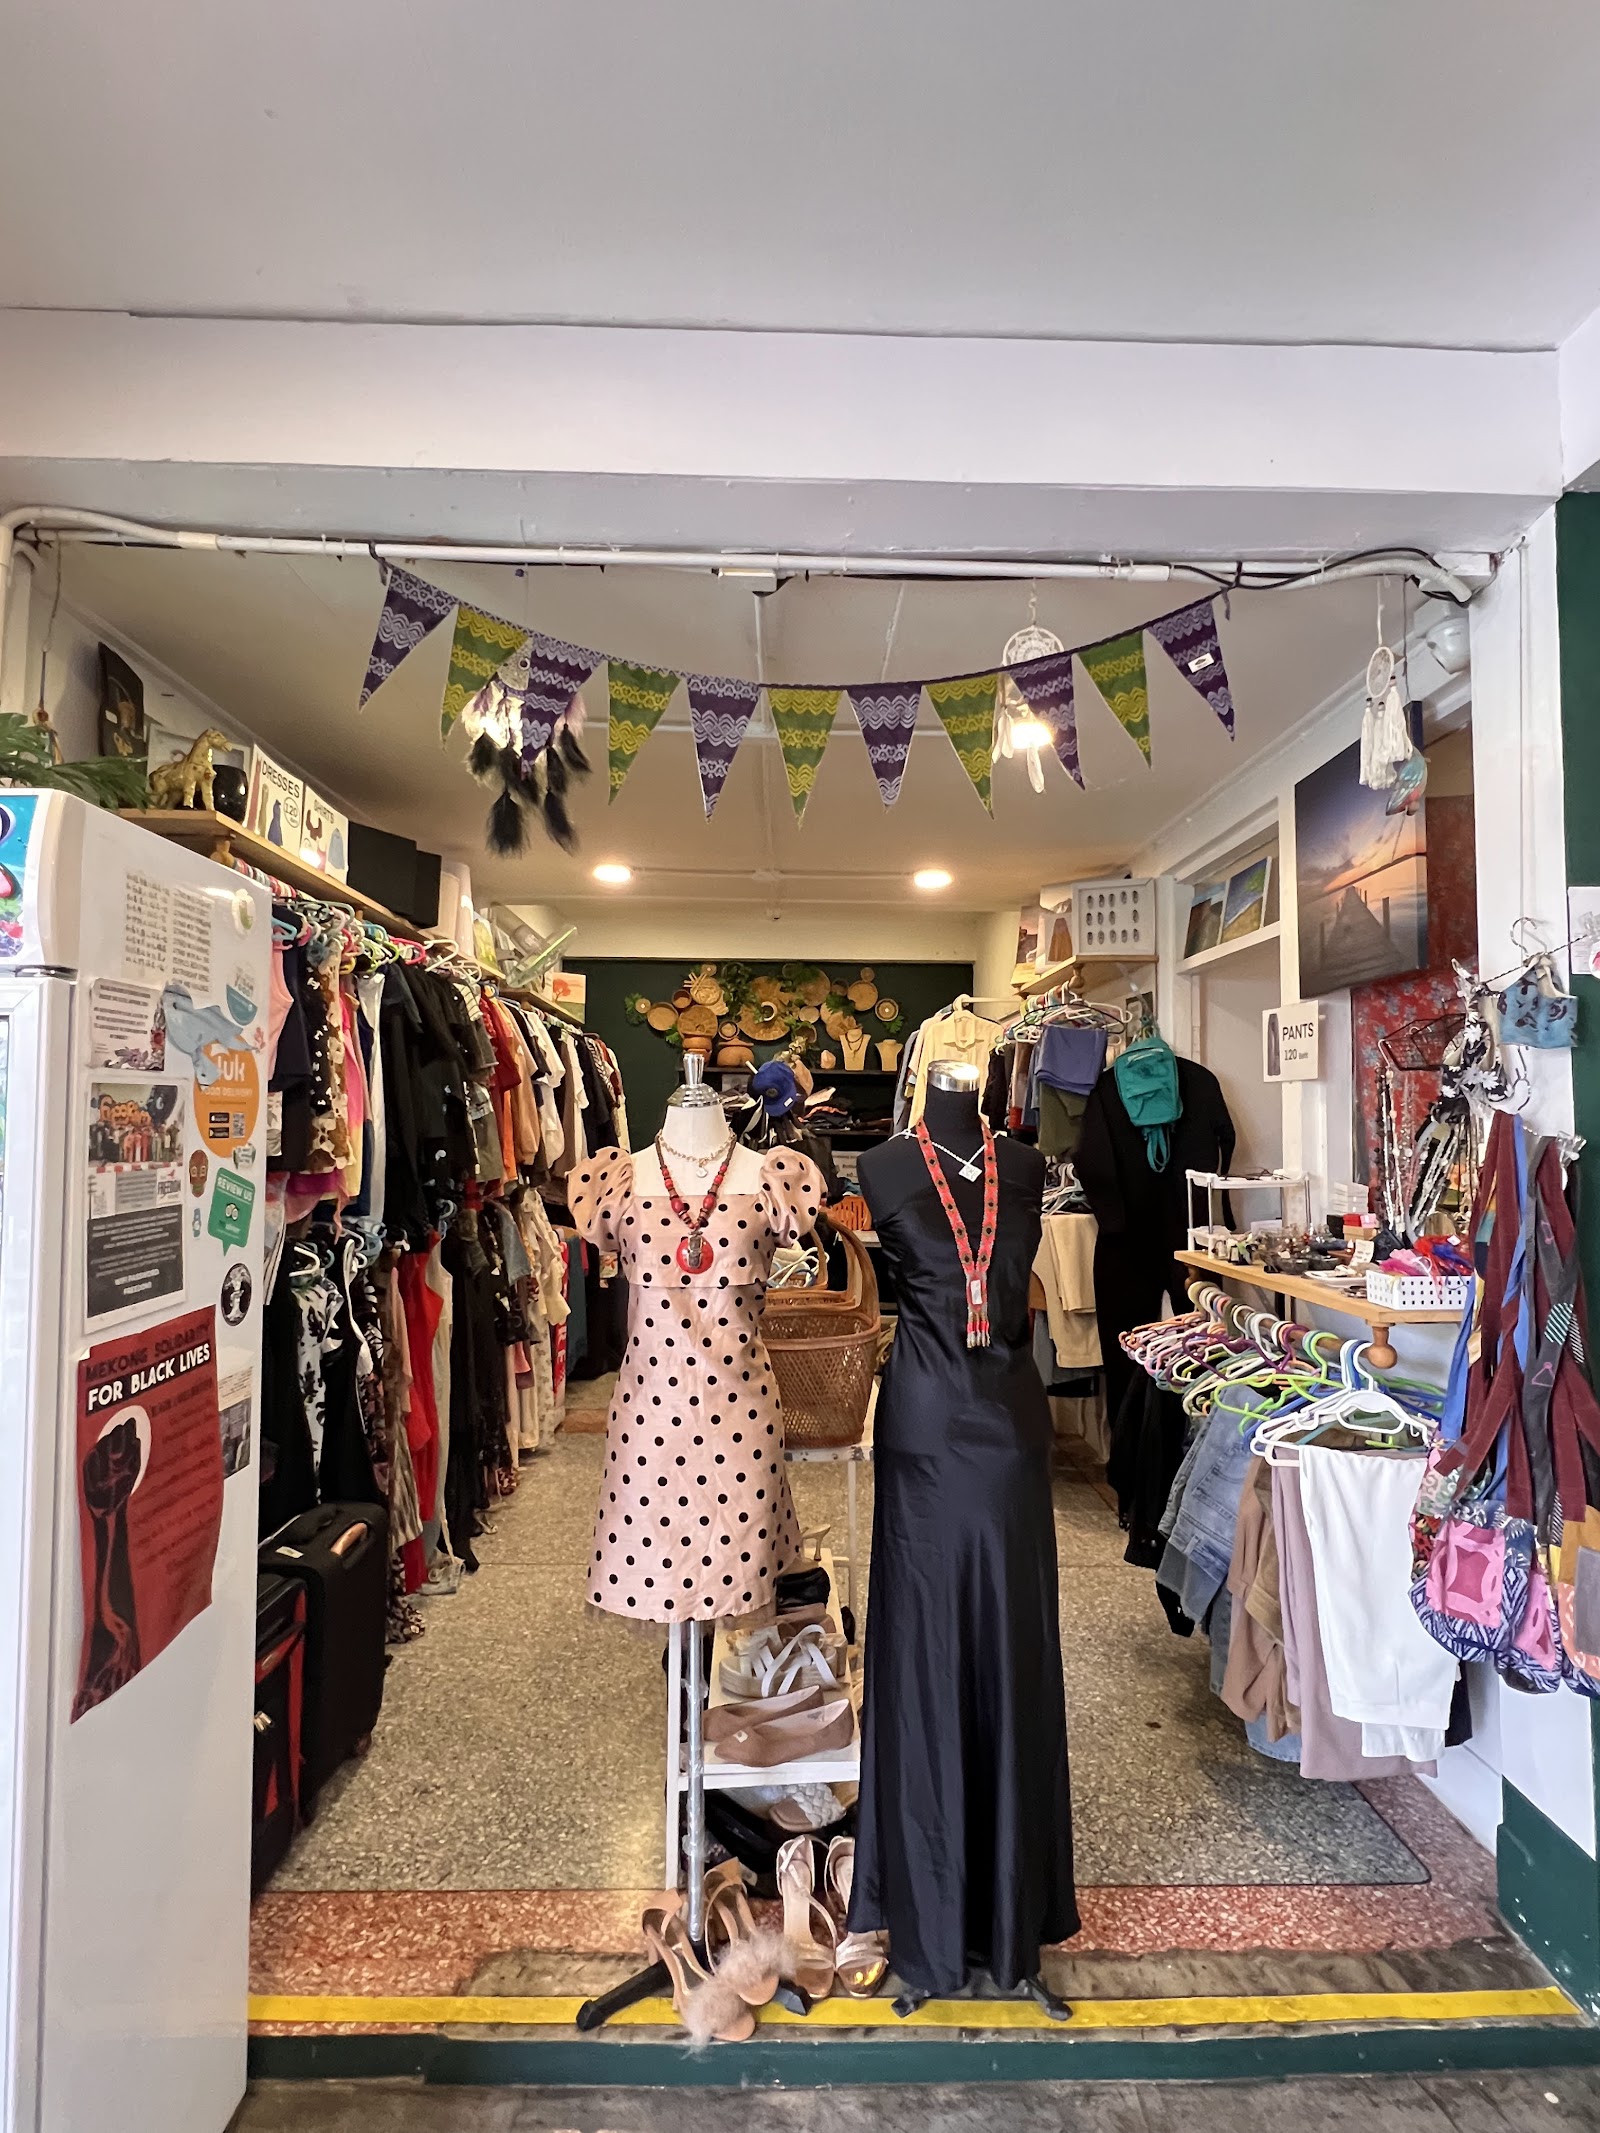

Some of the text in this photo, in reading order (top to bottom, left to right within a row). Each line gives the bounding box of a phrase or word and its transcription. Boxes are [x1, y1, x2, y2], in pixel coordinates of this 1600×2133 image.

[262, 761, 300, 799] DRESSES
[285, 803, 298, 818] 120
[1282, 1022, 1314, 1041] PANTS
[1284, 1048, 1298, 1061] 120
[217, 1176, 253, 1202] REVIEW US
[86, 1347, 148, 1380] MEKONG
[88, 1380, 123, 1411] FOR
[130, 1357, 175, 1394] BLACK
[180, 1343, 210, 1372] LIVES
